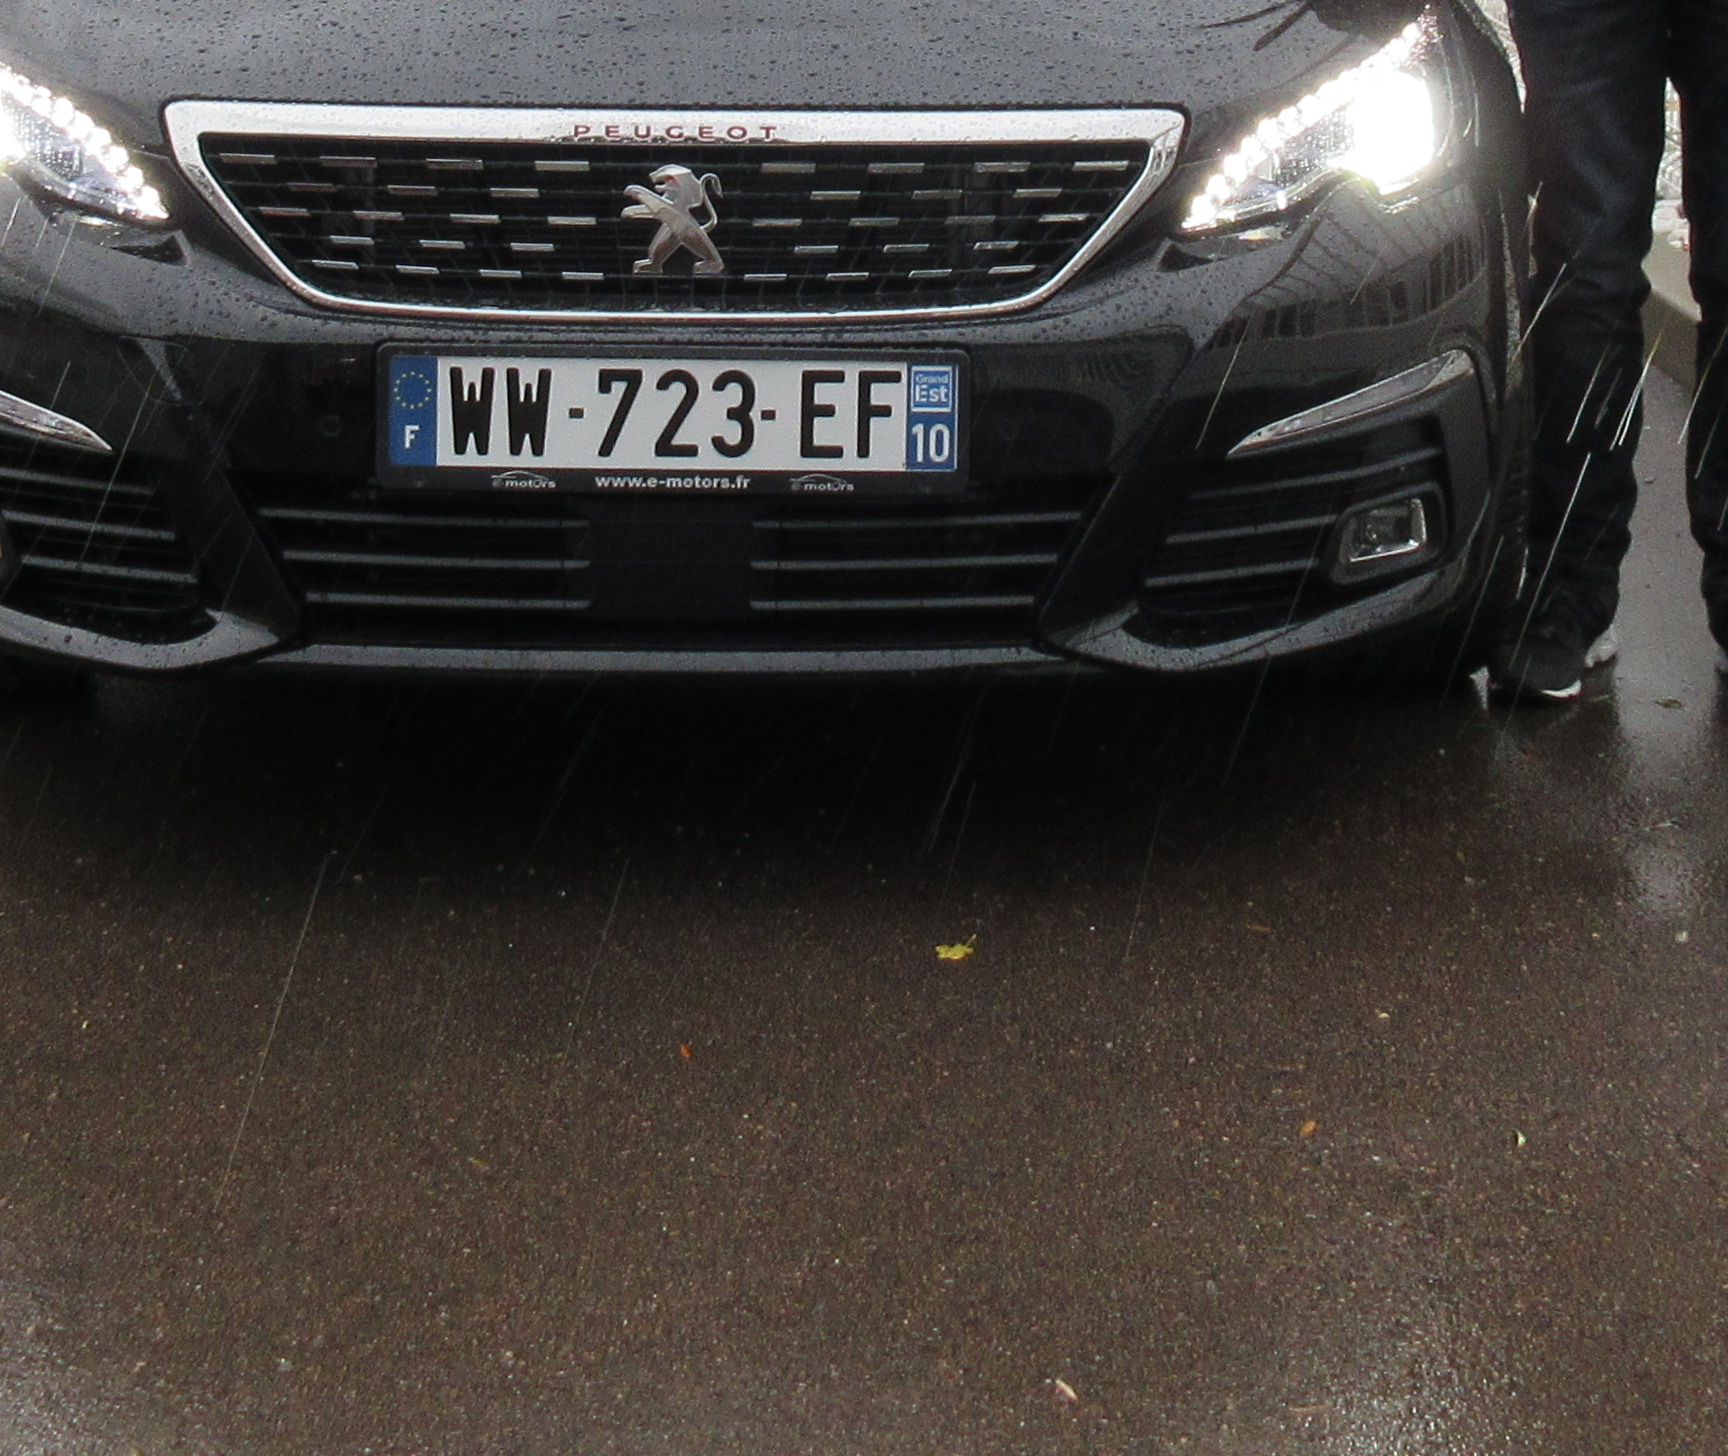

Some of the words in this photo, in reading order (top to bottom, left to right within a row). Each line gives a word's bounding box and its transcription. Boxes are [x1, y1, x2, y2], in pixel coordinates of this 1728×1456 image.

[573, 124, 777, 141] PEUGEOT
[915, 373, 949, 384] Grand
[914, 384, 949, 402] Est
[404, 424, 421, 449] F
[911, 422, 951, 463] 10
[594, 474, 751, 489] www.e-motors.fr
